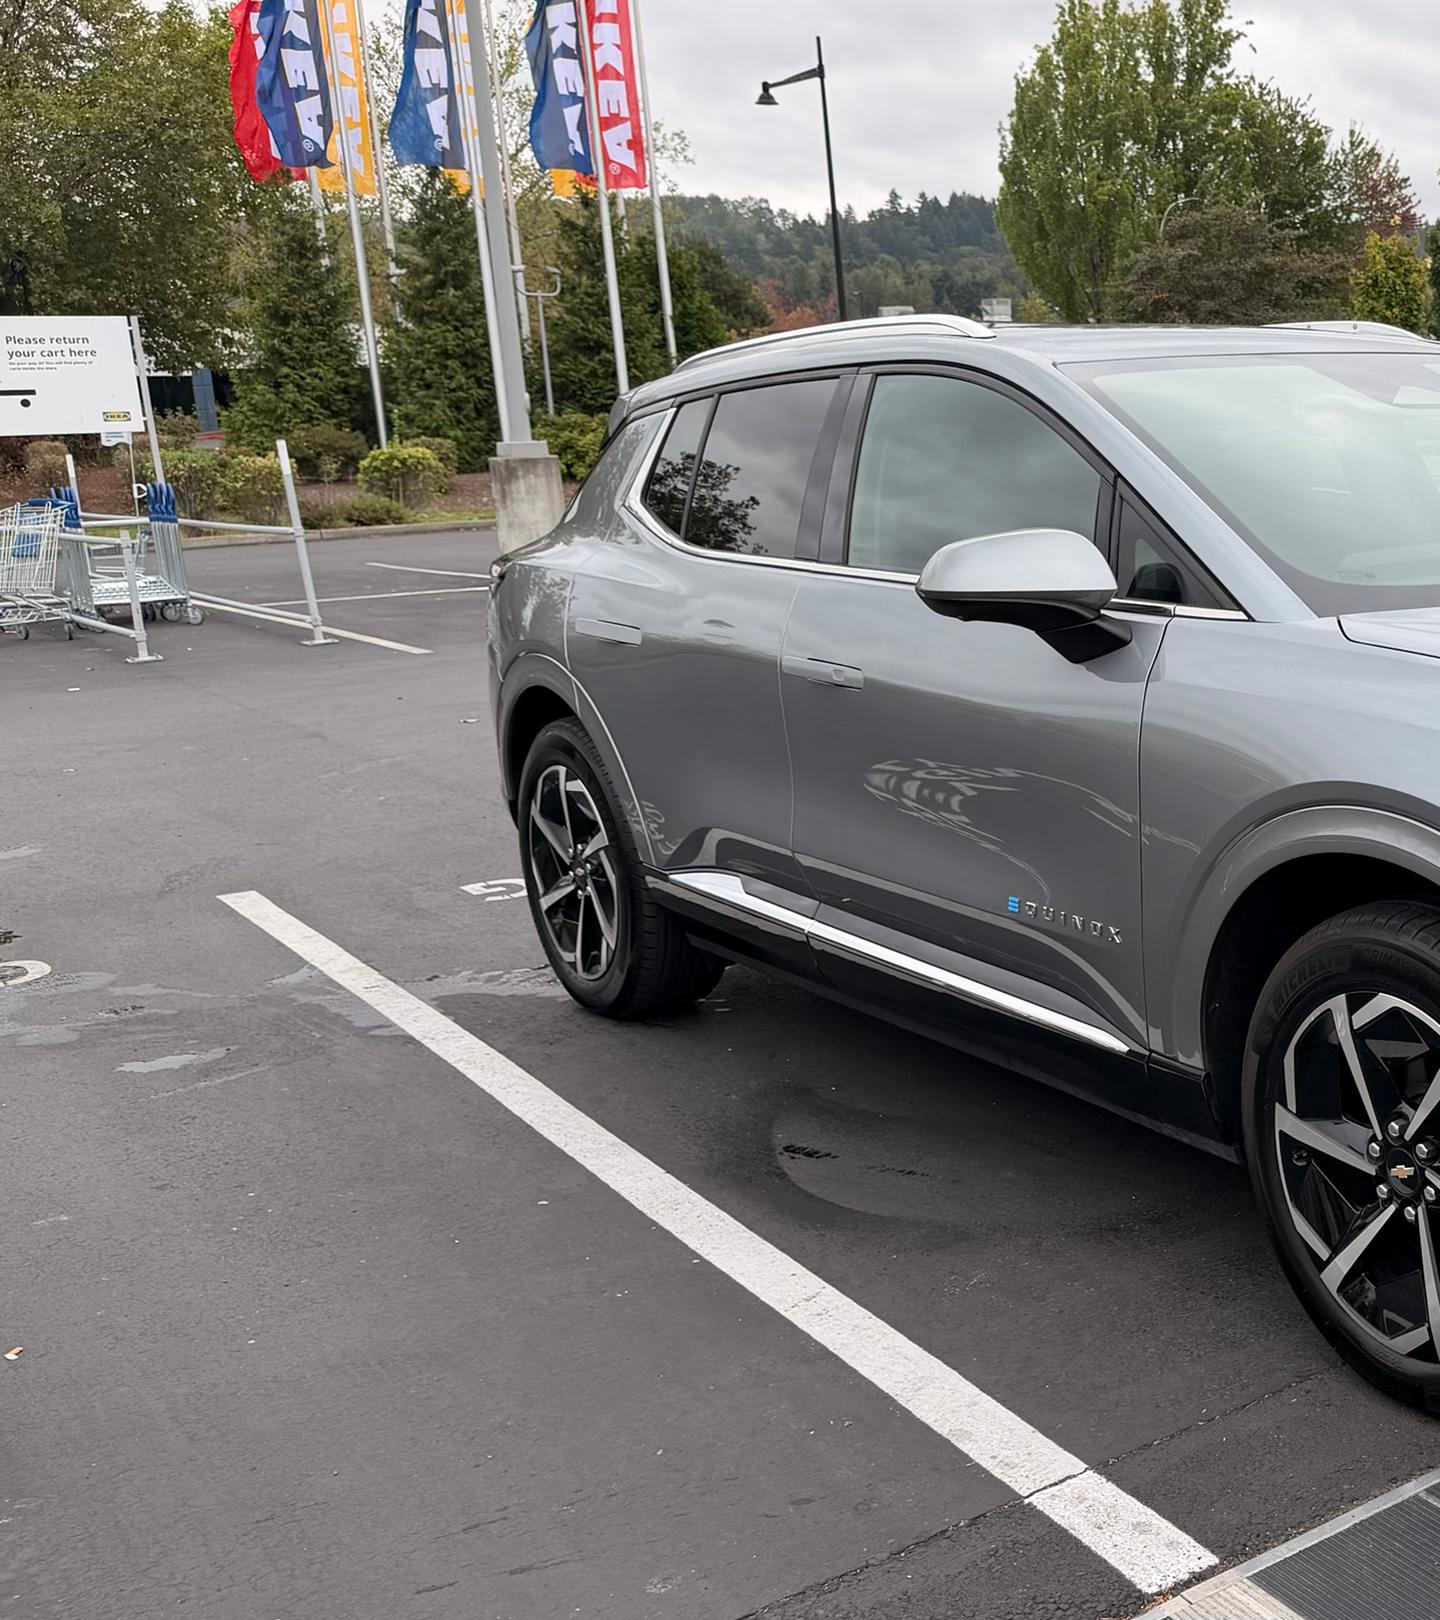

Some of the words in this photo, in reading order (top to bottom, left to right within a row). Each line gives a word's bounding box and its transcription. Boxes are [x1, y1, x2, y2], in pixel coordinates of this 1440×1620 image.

[5, 335, 46, 345] Please
[49, 335, 90, 345] return
[7, 349, 36, 361] your
[40, 349, 66, 358] cart
[69, 348, 97, 358] here
[1007, 895, 1123, 944] EQUINOX
